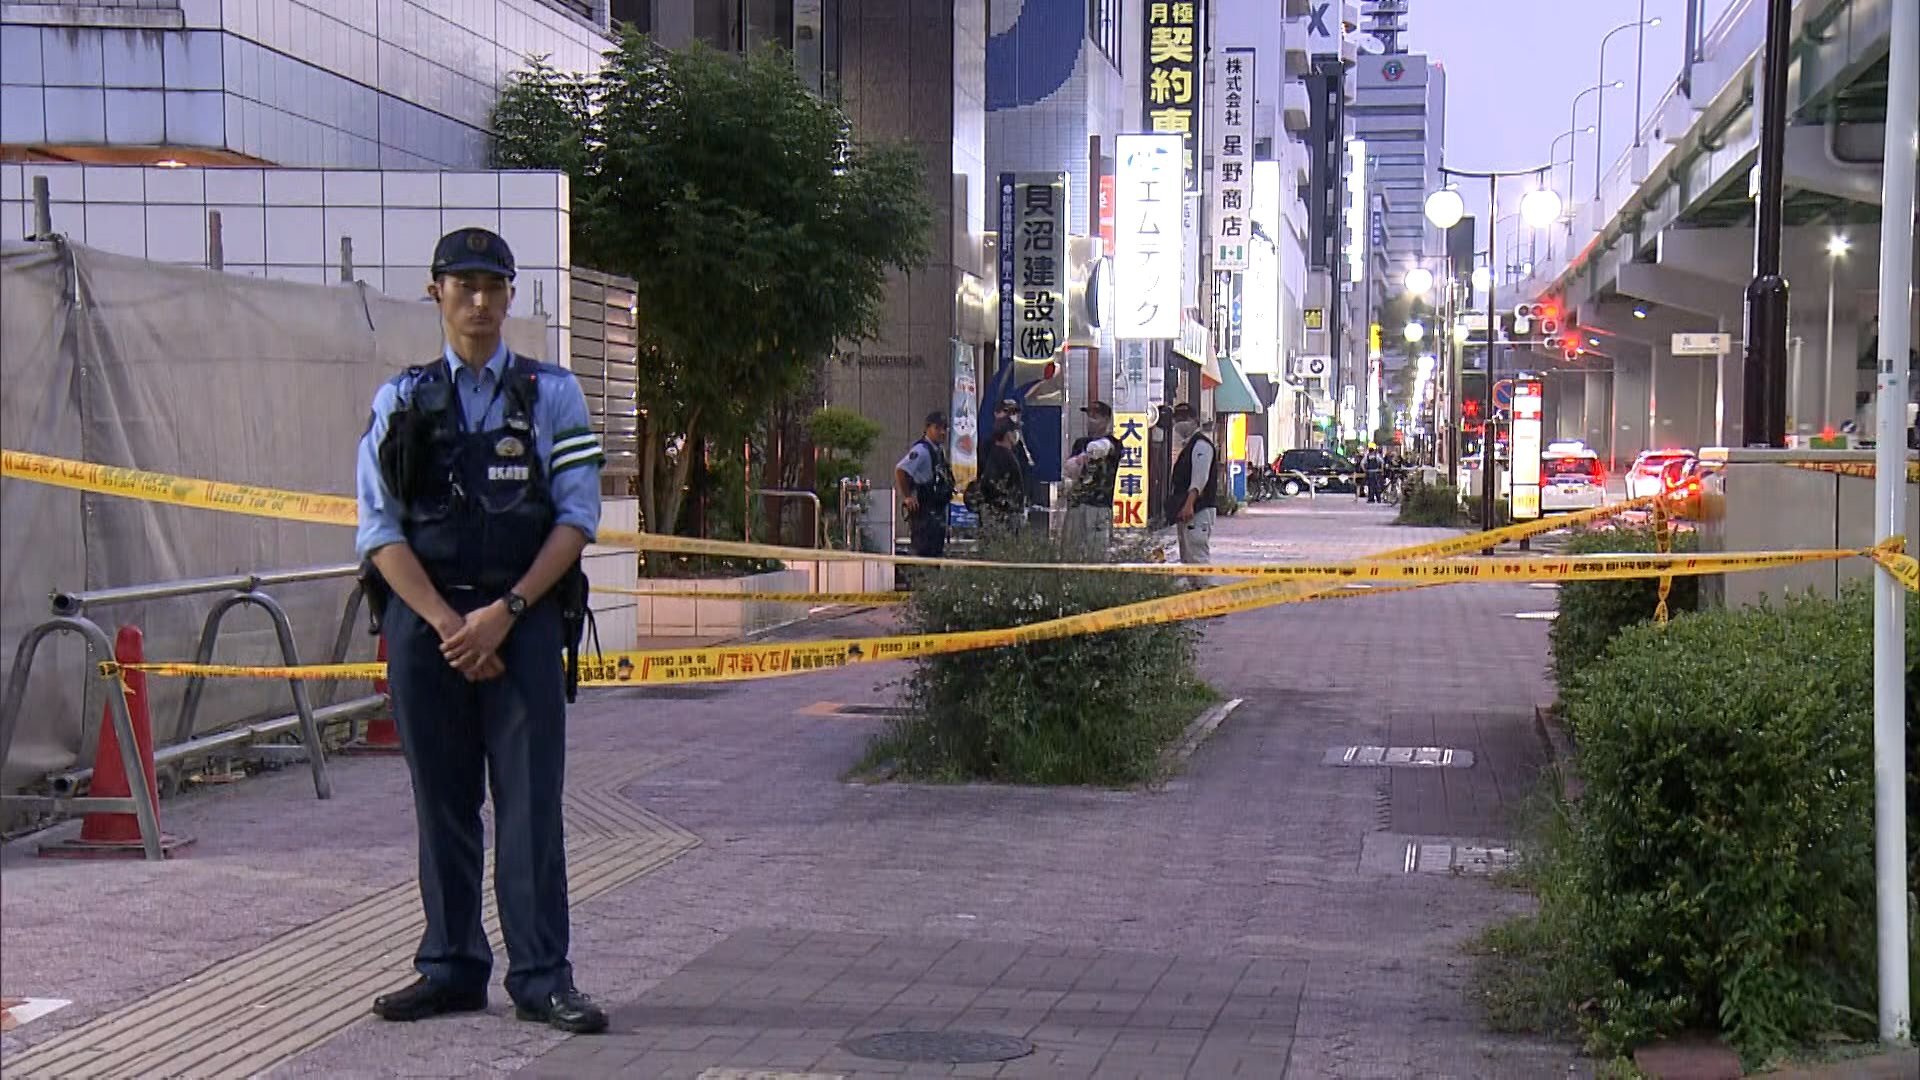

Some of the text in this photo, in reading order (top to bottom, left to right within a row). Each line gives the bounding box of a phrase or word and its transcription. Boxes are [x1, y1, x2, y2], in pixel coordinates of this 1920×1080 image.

[1150, 2, 1194, 24] 月極
[1118, 419, 1143, 497] 大型車
[727, 650, 783, 674] 立入禁止
